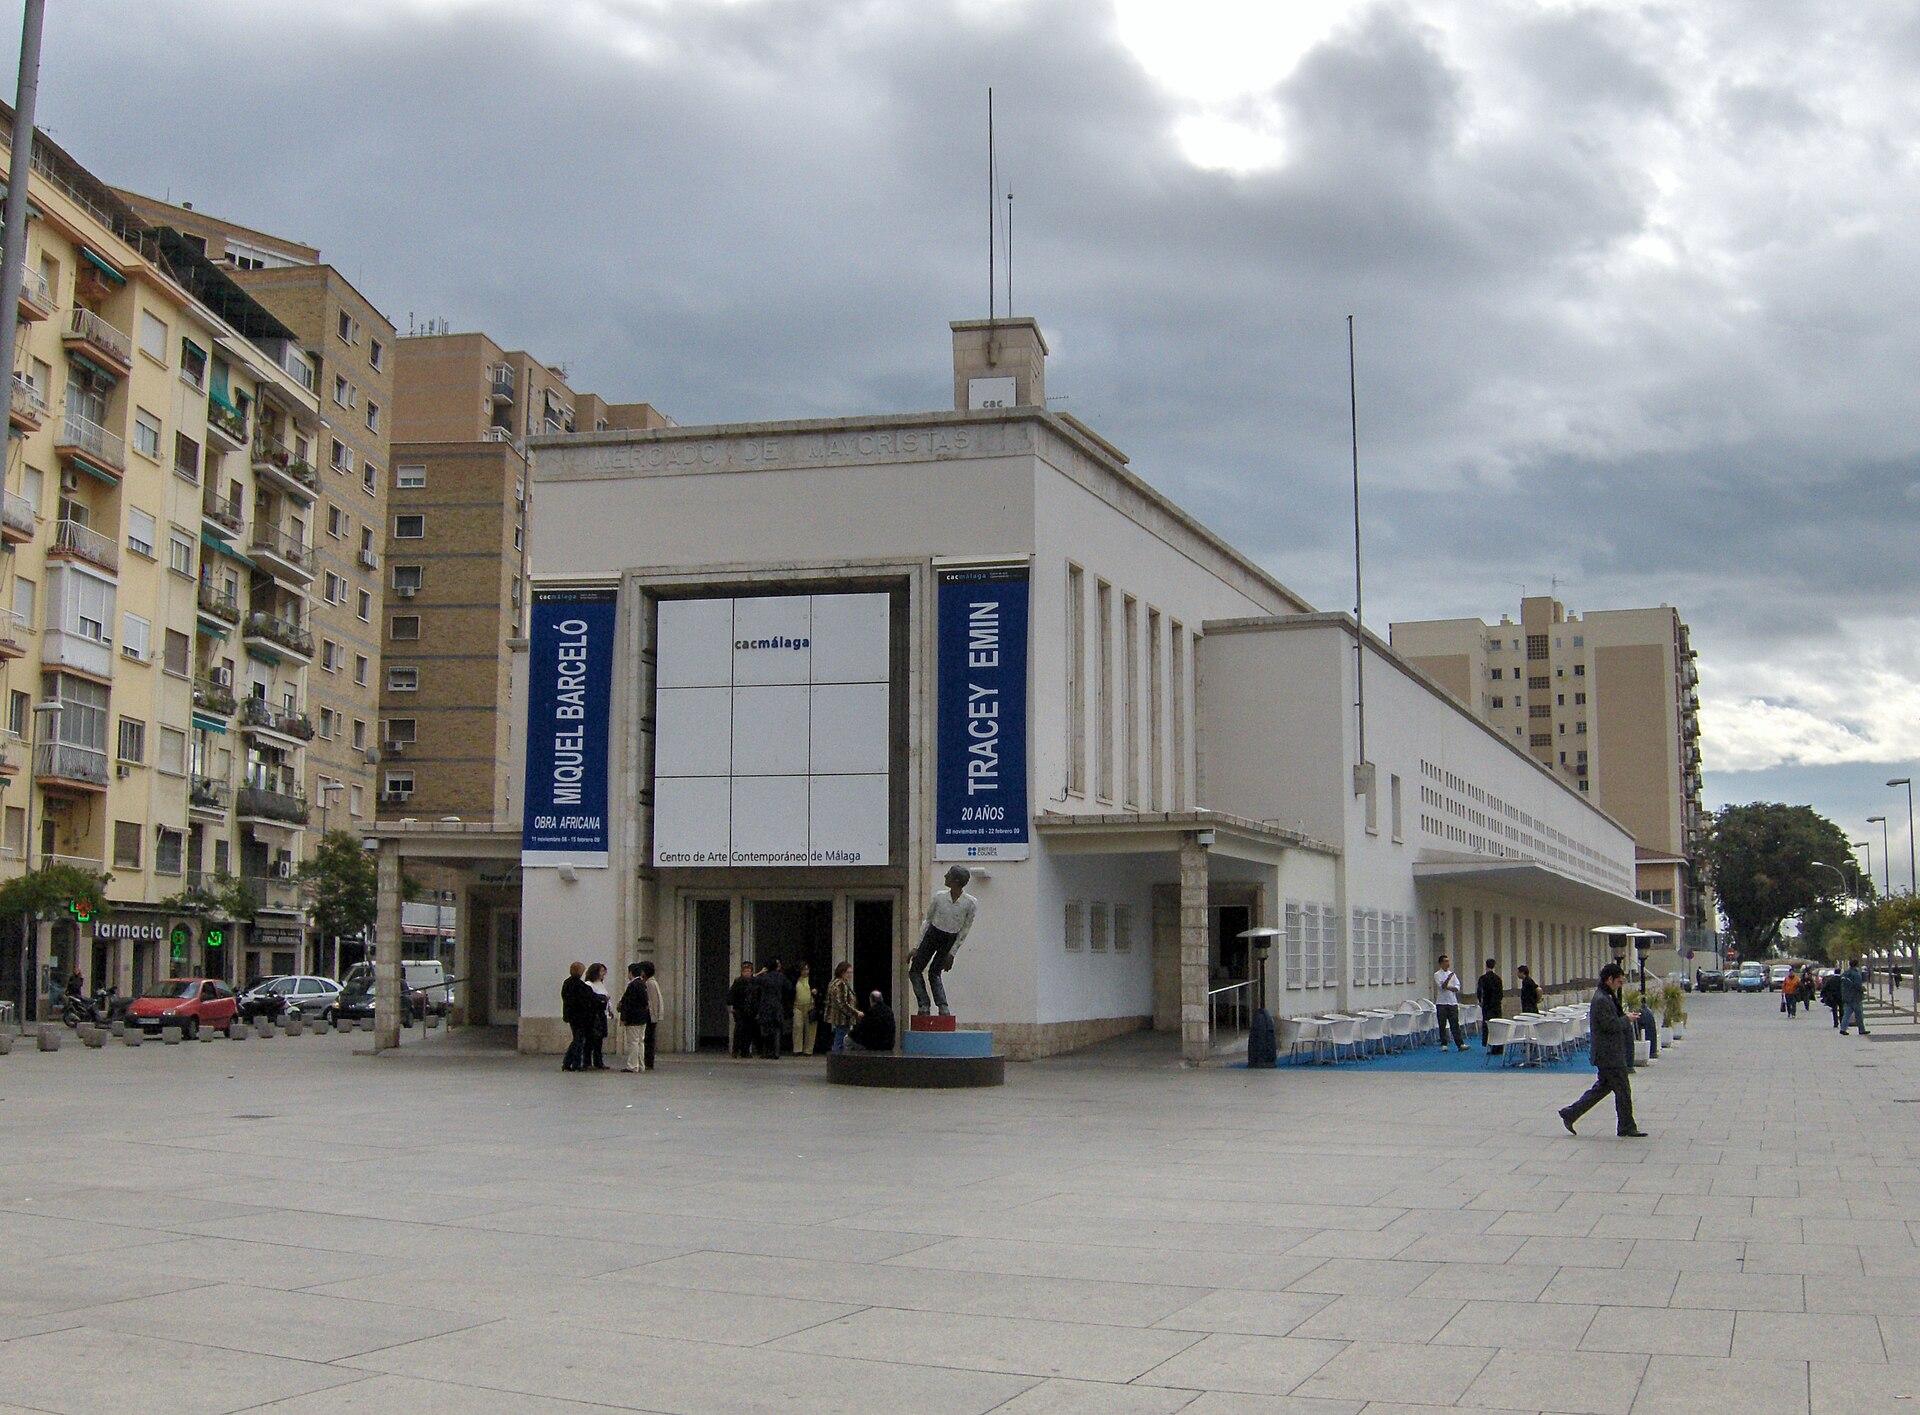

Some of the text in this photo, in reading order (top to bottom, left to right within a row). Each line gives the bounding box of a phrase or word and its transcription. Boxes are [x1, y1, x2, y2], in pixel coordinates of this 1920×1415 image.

[742, 441, 779, 462] DE
[734, 636, 810, 650] cacmálaga
[968, 602, 999, 795] TRACEY EMIN
[552, 619, 588, 804] MIQUEL BARCELÓ
[961, 804, 1005, 820] 20 AÑOS
[534, 816, 601, 829] OBRA AFRICANA
[659, 850, 861, 864] Centro de Arte Contemporáneo de Málaga
